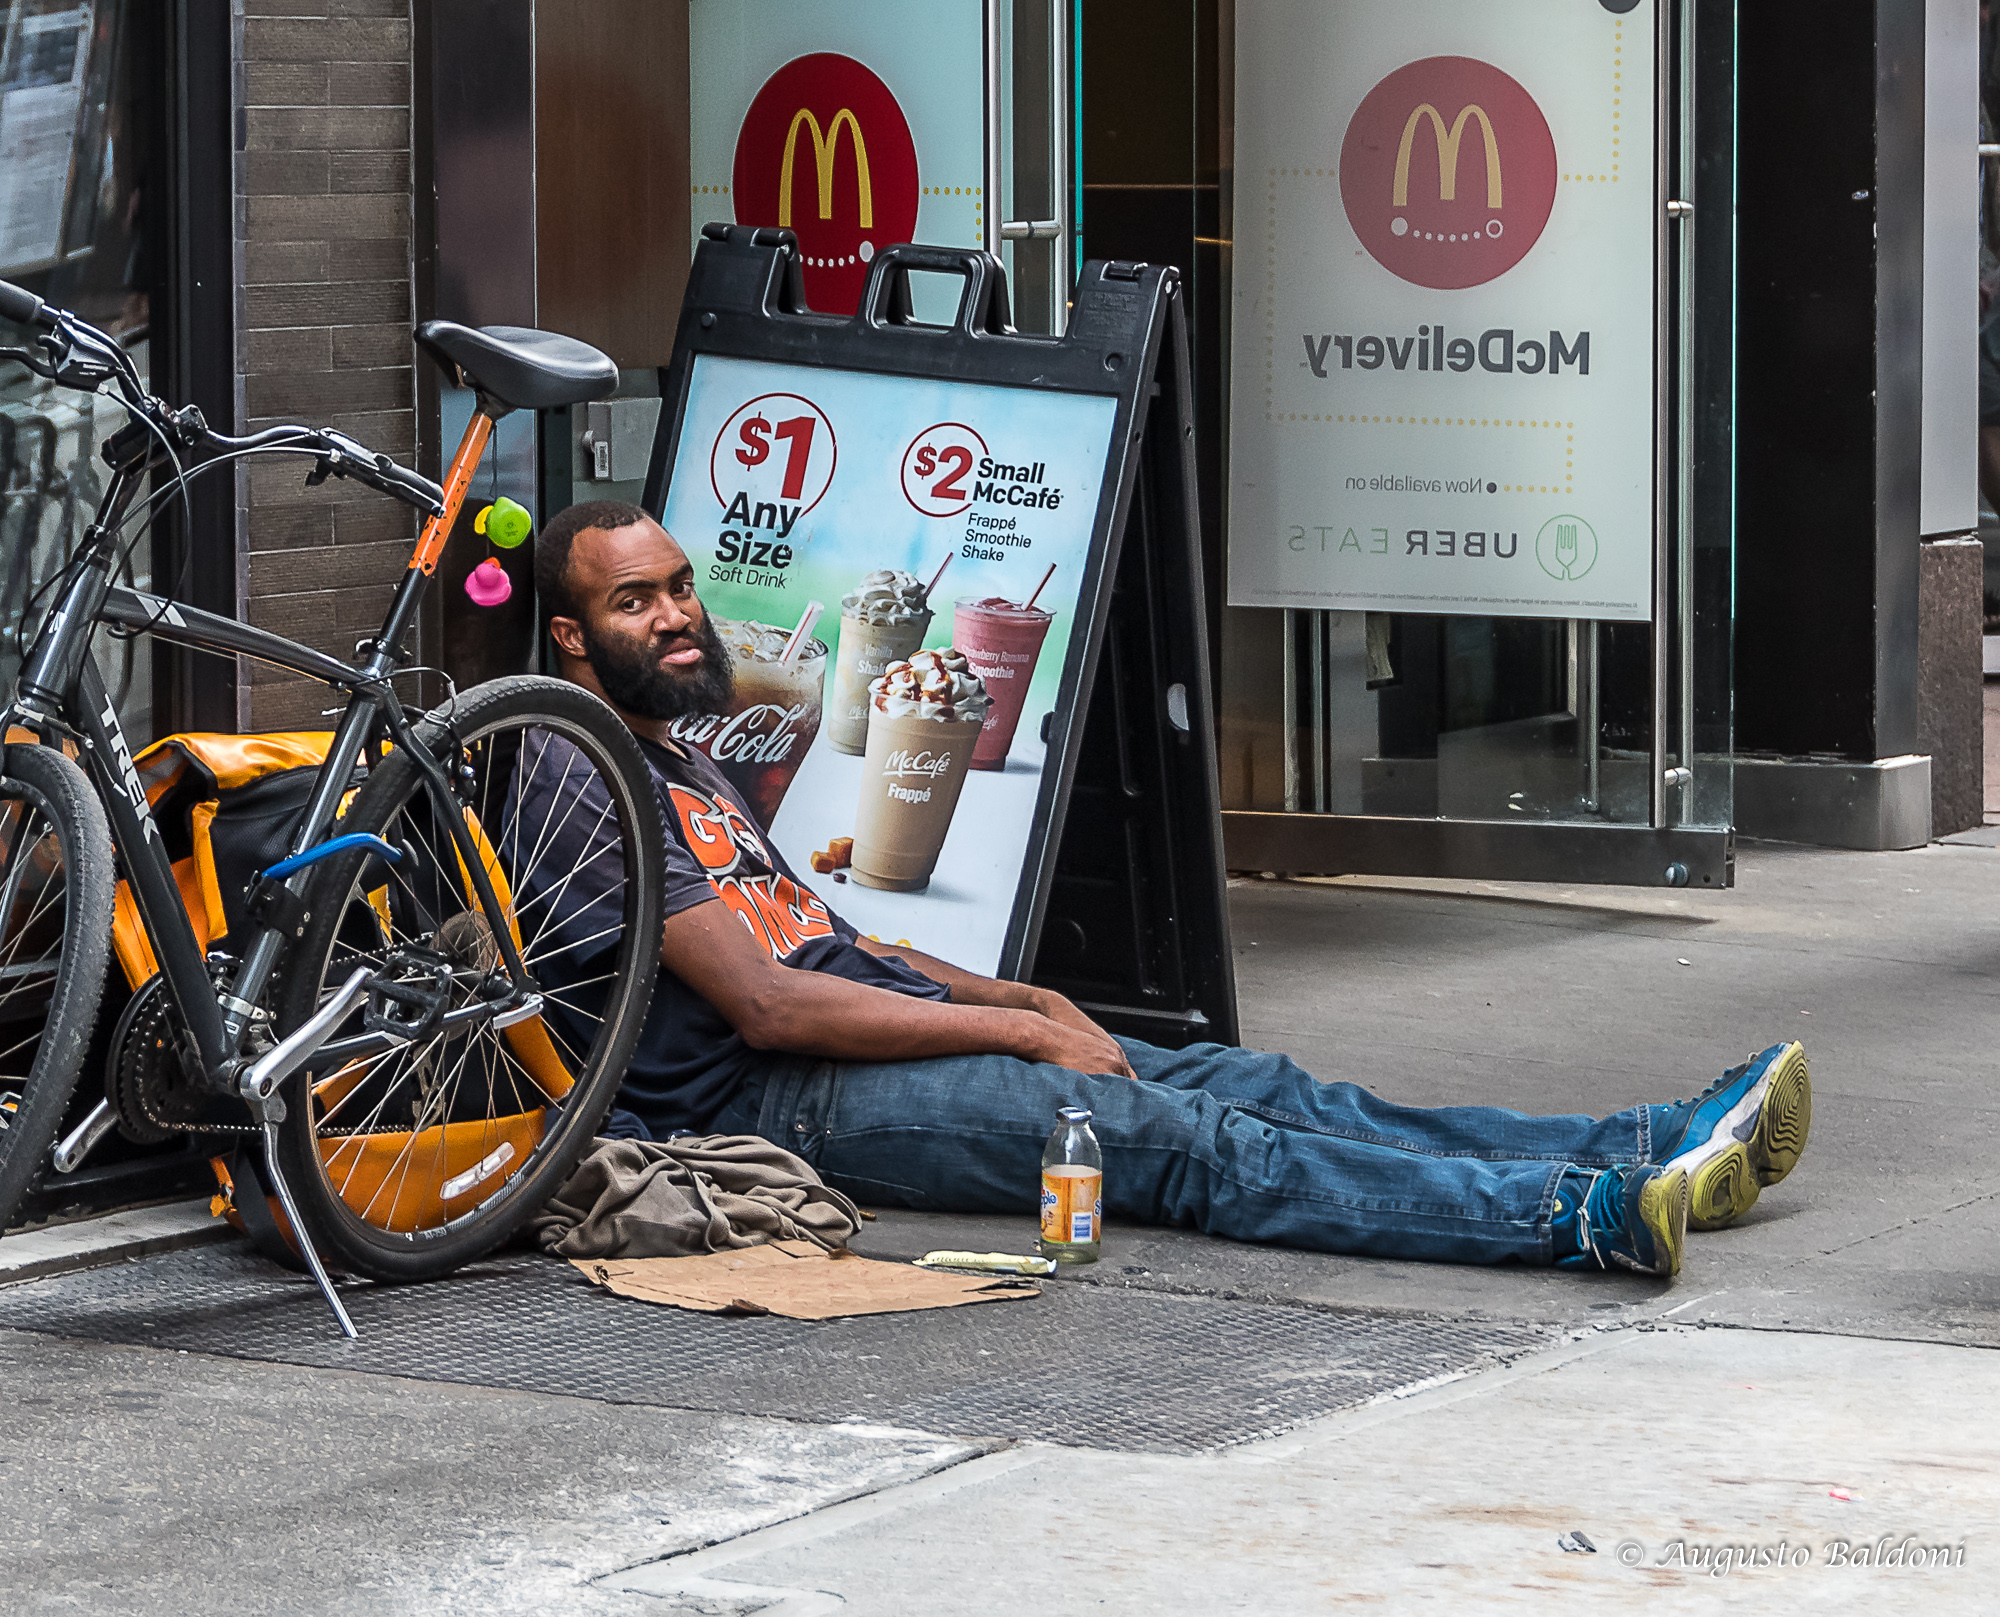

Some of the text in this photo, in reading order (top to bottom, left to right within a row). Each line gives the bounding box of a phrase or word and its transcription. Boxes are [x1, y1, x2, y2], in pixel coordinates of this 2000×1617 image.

[735, 411, 816, 500] $1
[913, 442, 973, 501] $2
[977, 457, 1046, 484] Small
[972, 481, 1061, 510] McCafé
[721, 491, 802, 539] Any
[968, 512, 1017, 531] Frappé
[715, 530, 793, 569] Size
[964, 529, 1032, 548] Smoothie
[961, 544, 1004, 562] Shake
[709, 564, 788, 589] Soft Drink
[968, 662, 1015, 678] Smoothie
[101, 693, 159, 844] TREK
[883, 749, 951, 779] McCafé
[887, 782, 932, 804] Frappé
